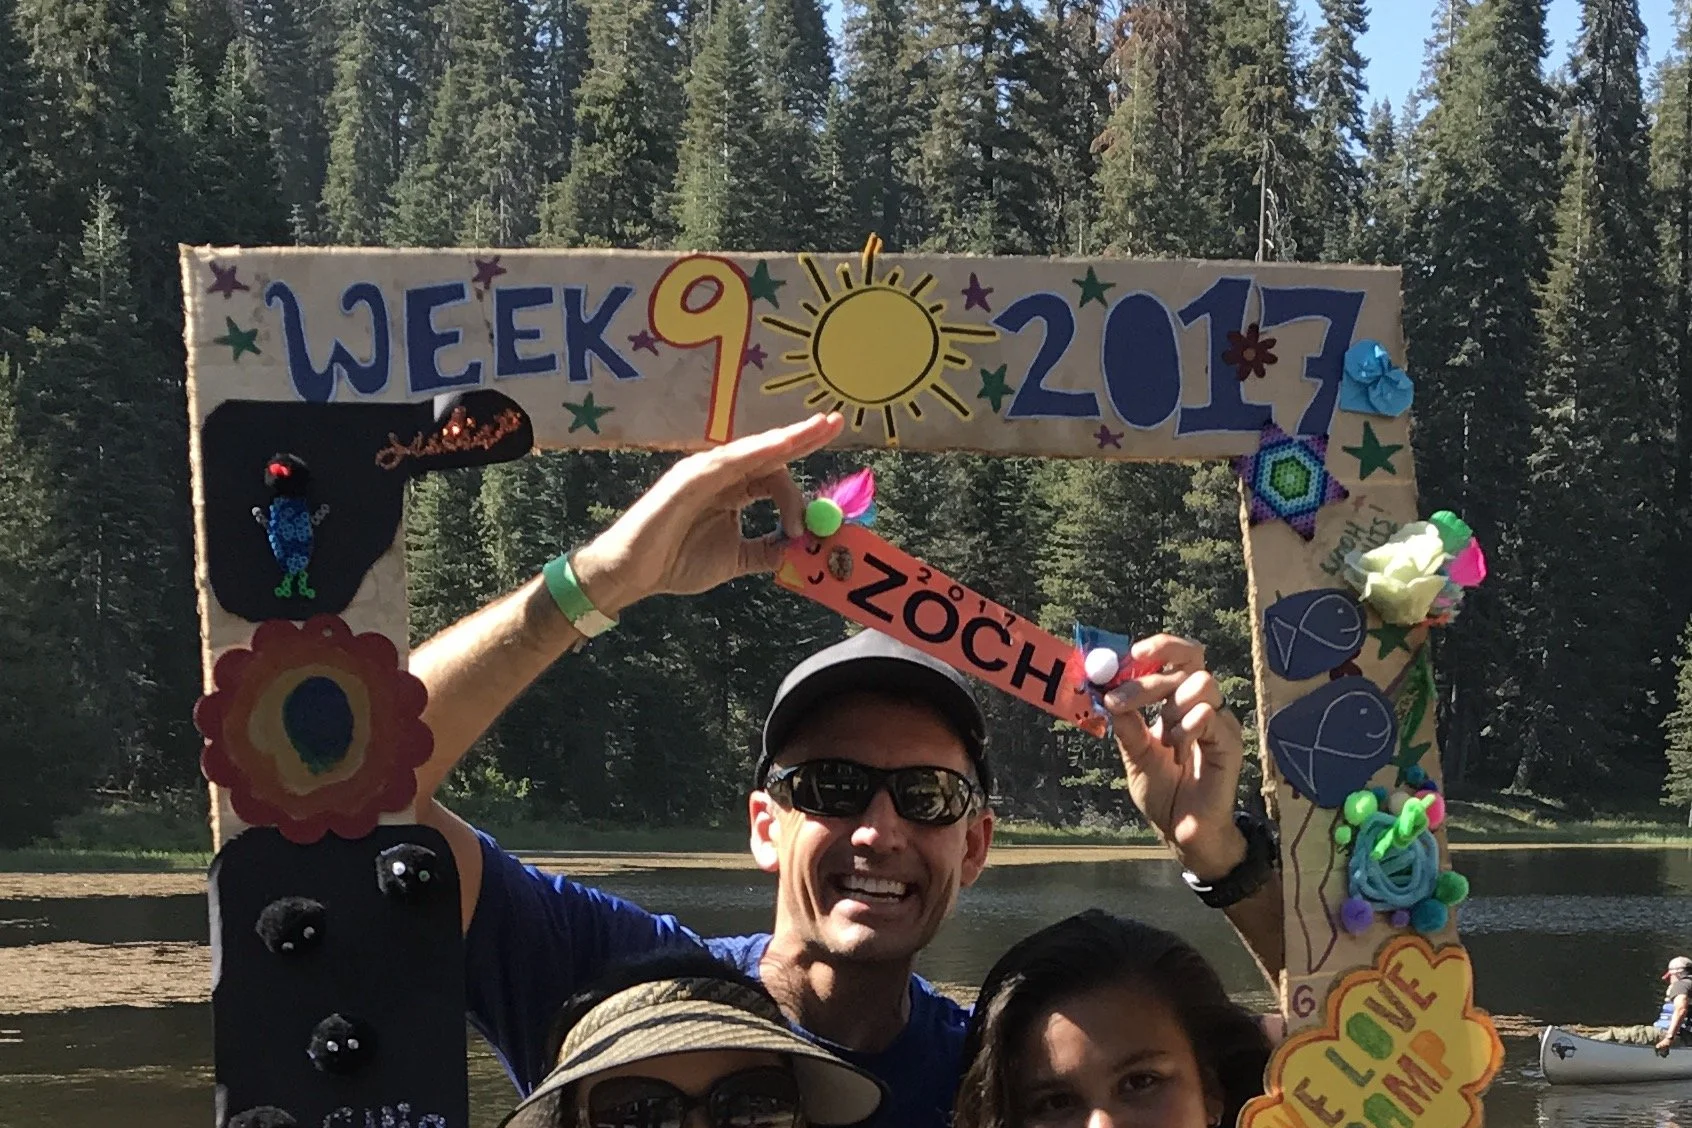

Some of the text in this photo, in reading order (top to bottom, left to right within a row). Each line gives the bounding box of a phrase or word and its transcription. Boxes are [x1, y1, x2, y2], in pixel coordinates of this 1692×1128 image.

[265, 280, 645, 401] WEEK
[648, 253, 753, 445] 9
[989, 275, 1366, 438] 2017
[846, 552, 1067, 704] ZOCH
[917, 566, 1017, 628] 2017
[1324, 960, 1437, 1088] LOVE
